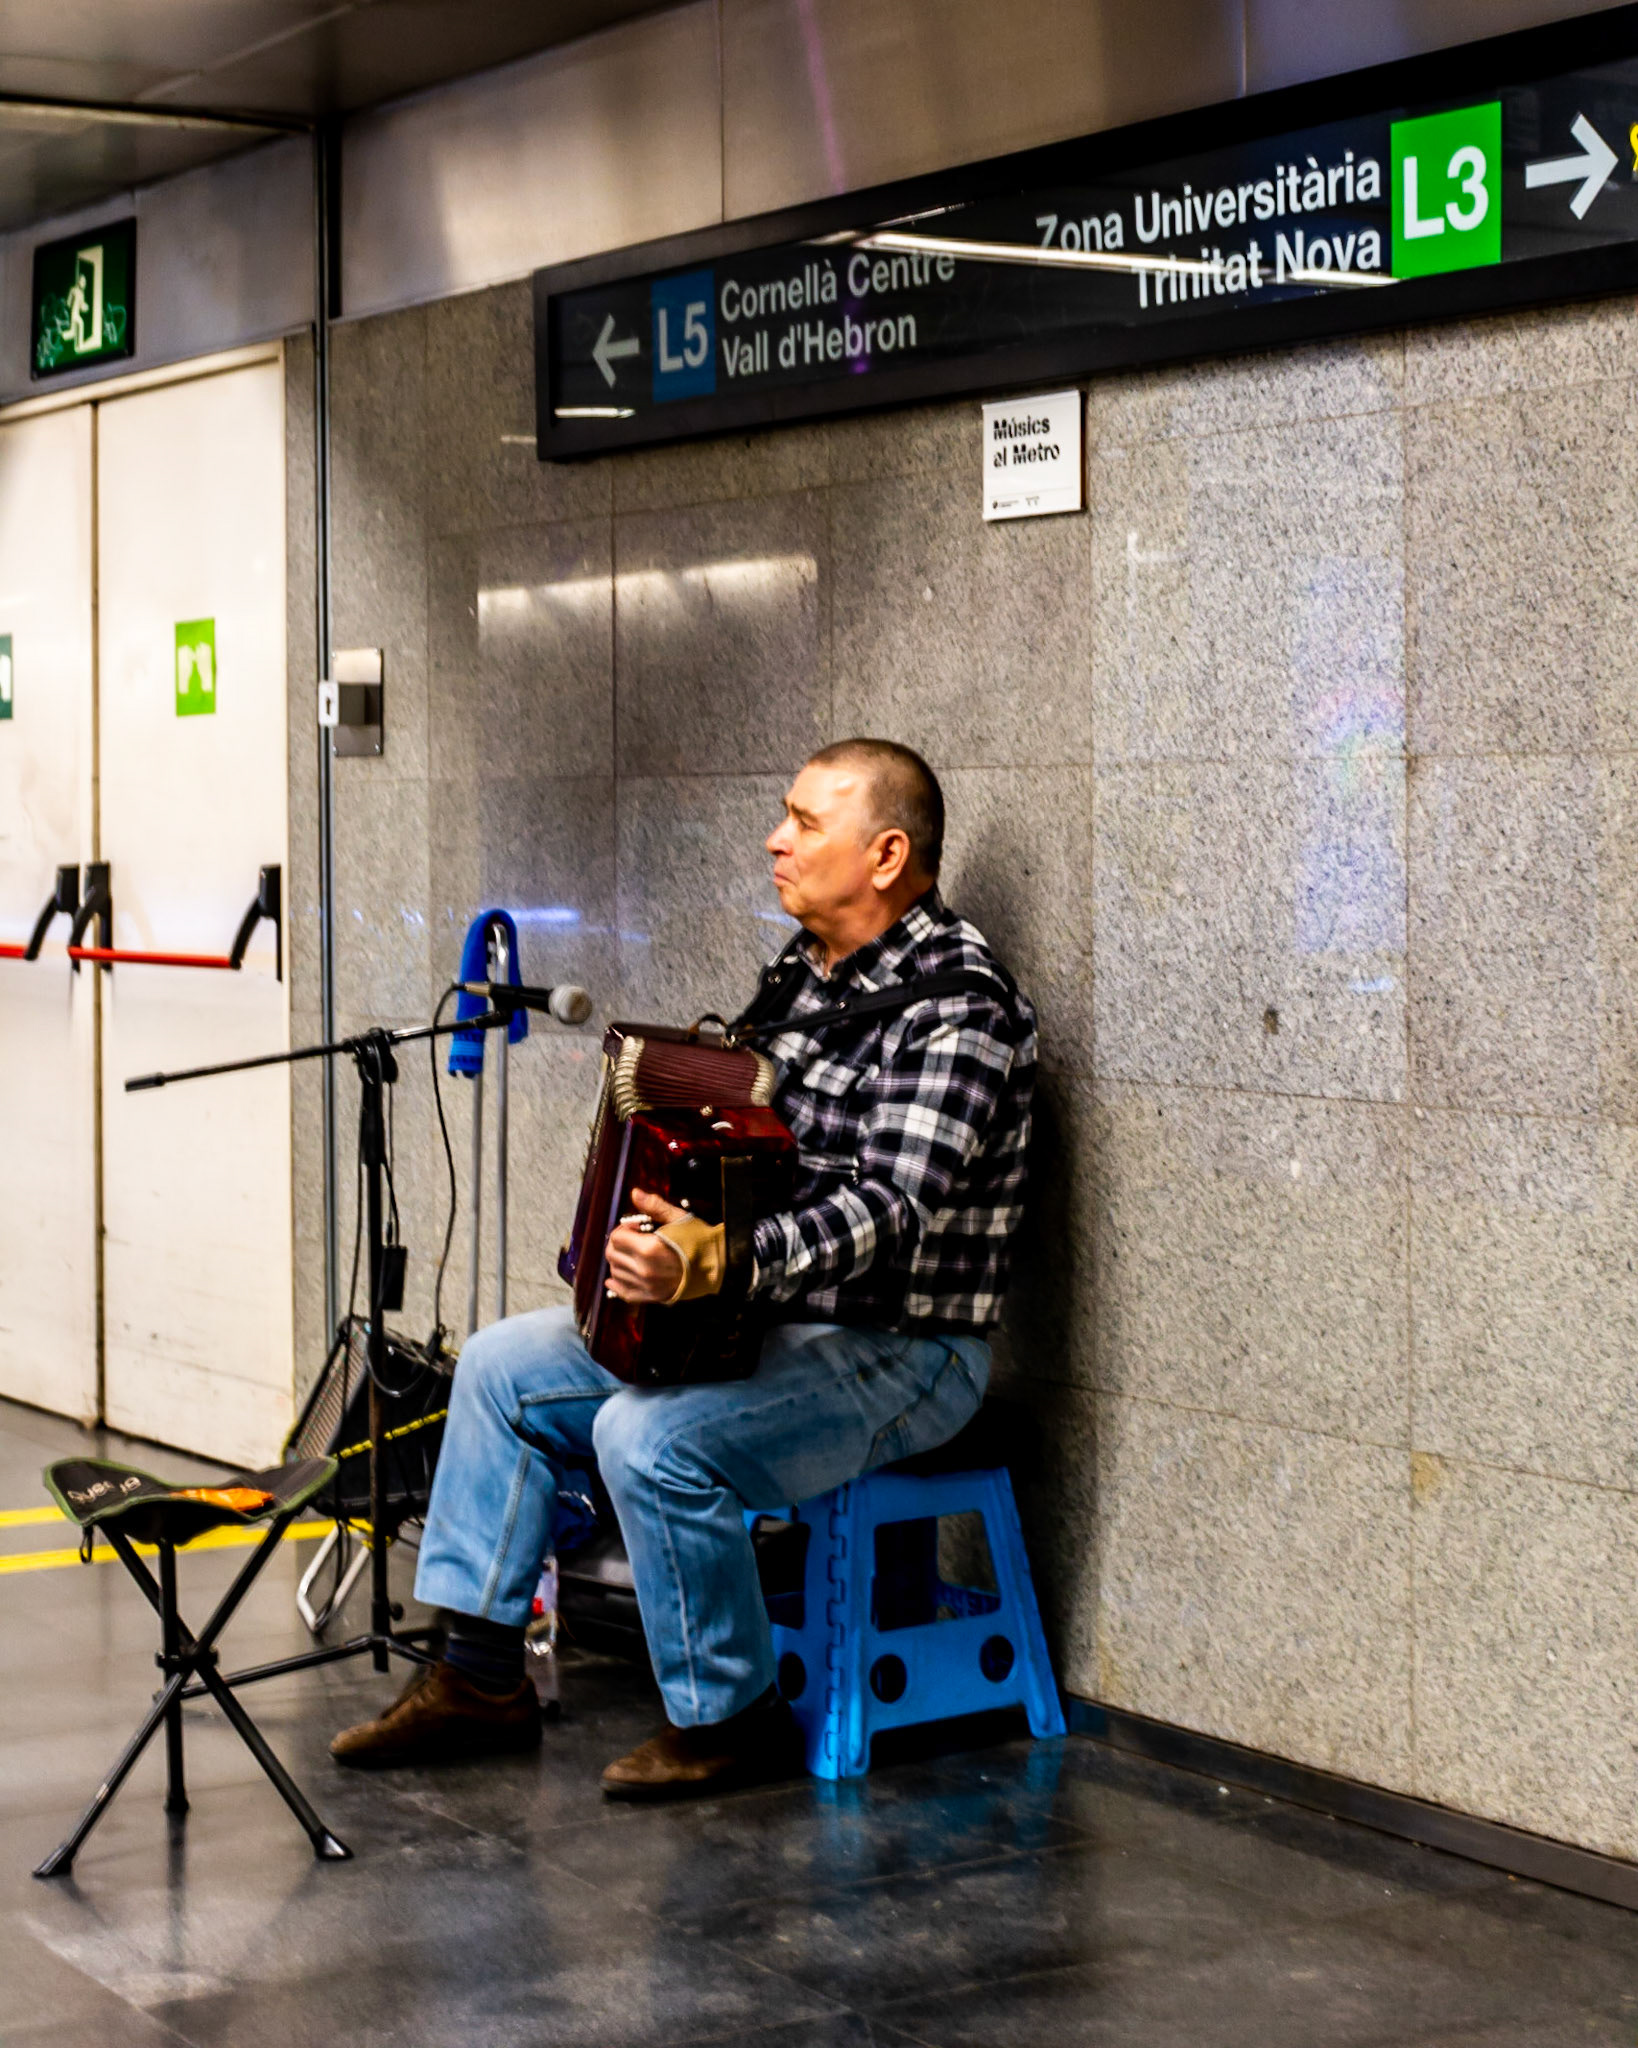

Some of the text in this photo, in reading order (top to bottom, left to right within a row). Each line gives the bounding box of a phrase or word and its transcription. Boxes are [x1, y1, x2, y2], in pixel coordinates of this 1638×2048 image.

[1036, 152, 1381, 254] Zona Universitària
[1403, 146, 1490, 241] L3
[721, 249, 956, 323] Cornellà Centre
[1131, 229, 1382, 309] Trinitat Nova
[658, 302, 709, 373] L5
[722, 314, 918, 378] Vall d'Hebron
[993, 415, 1051, 441] Músics
[993, 442, 1061, 468] al Metro
